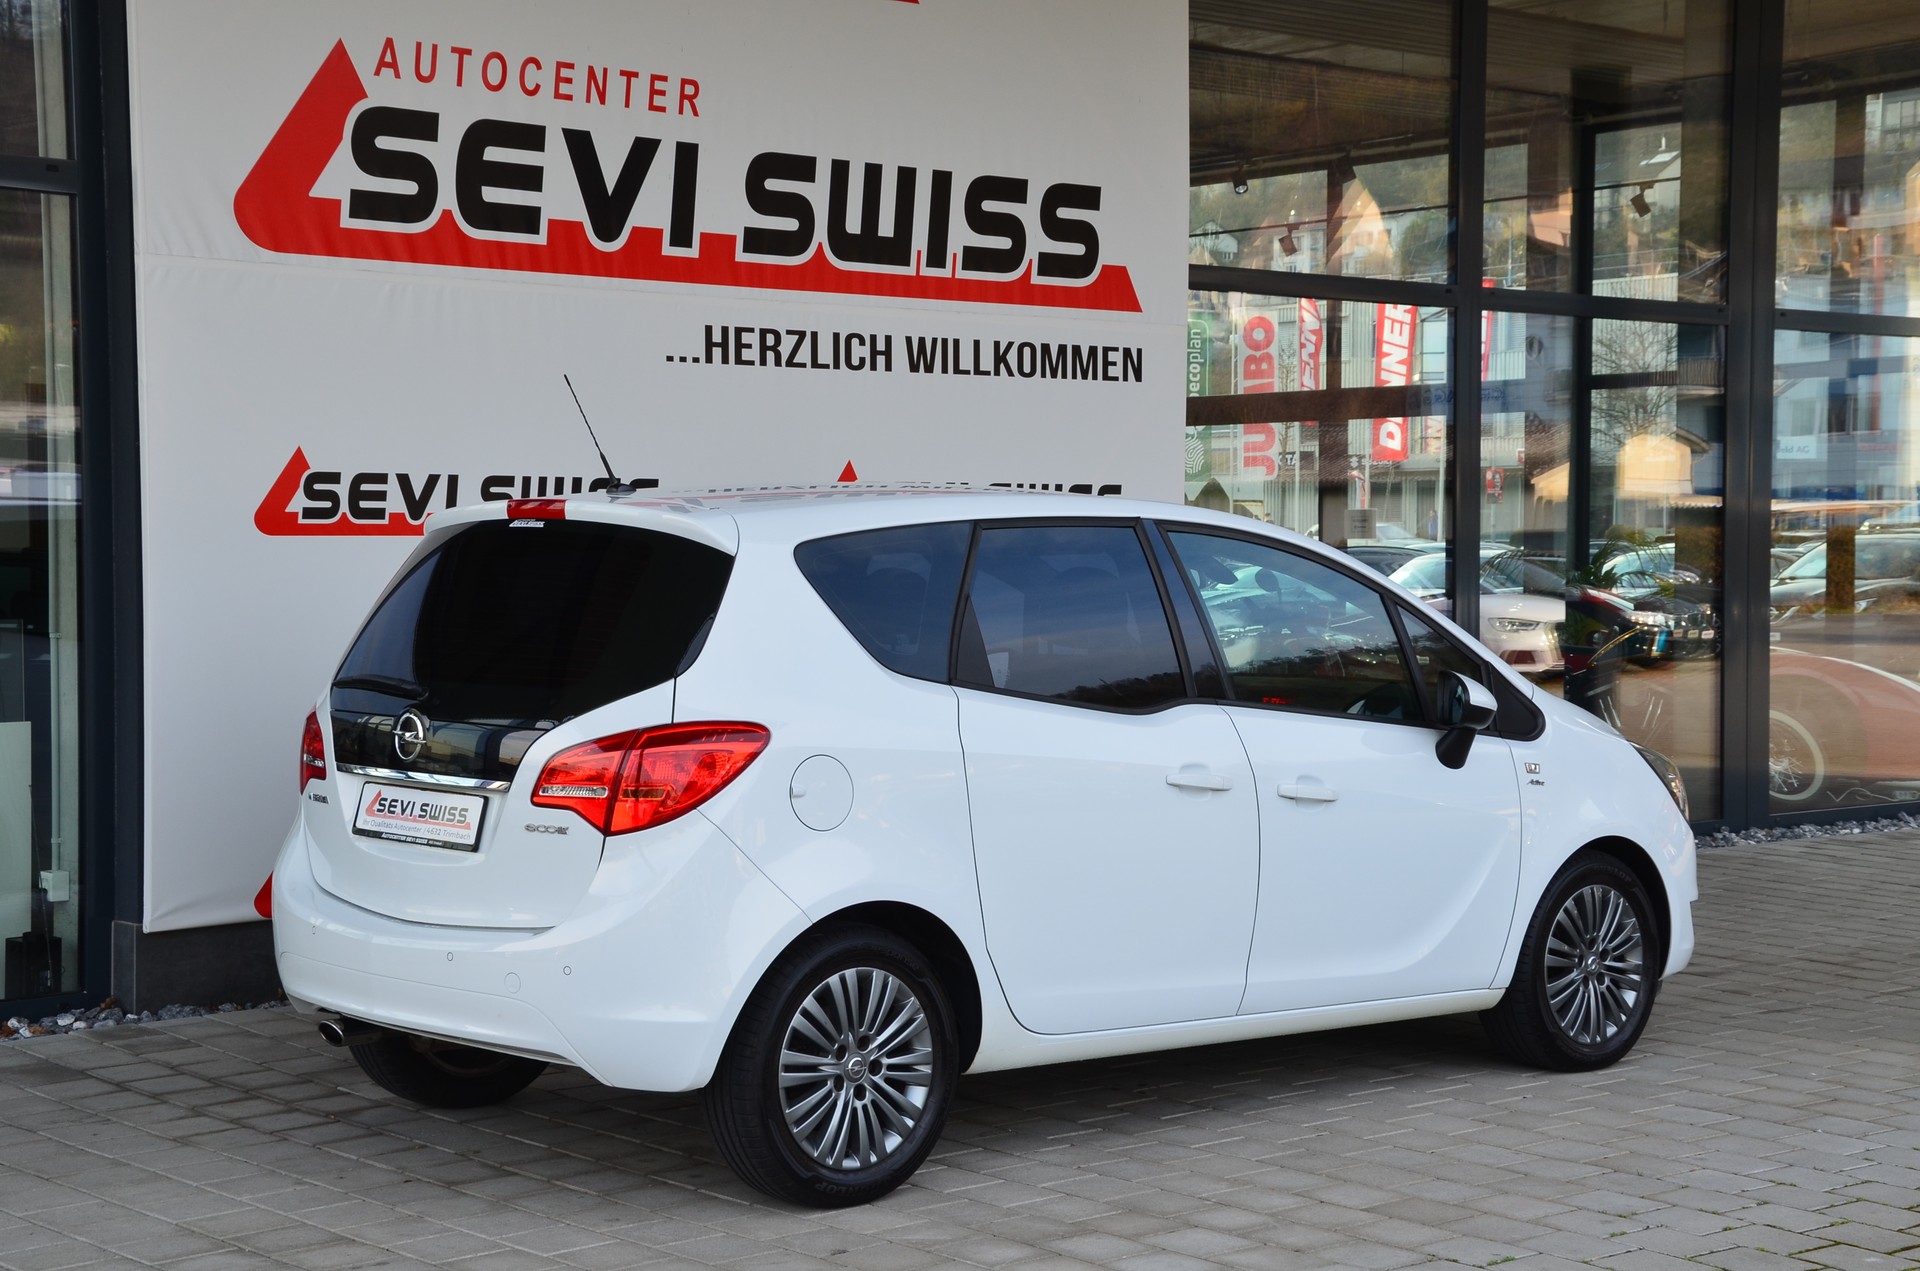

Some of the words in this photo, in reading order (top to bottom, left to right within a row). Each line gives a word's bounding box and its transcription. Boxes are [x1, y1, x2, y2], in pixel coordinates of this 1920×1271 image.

[374, 37, 700, 117] AUTOCENTER
[348, 105, 699, 249] SEVI
[742, 151, 1102, 280] SWISS
[904, 335, 1144, 383] WILLKOMMEN
[1242, 315, 1278, 480] JUBO
[302, 471, 459, 521] SEVI
[376, 797, 416, 817] SEVI
[418, 802, 469, 824] SWISS
[427, 828, 441, 836] 4632
